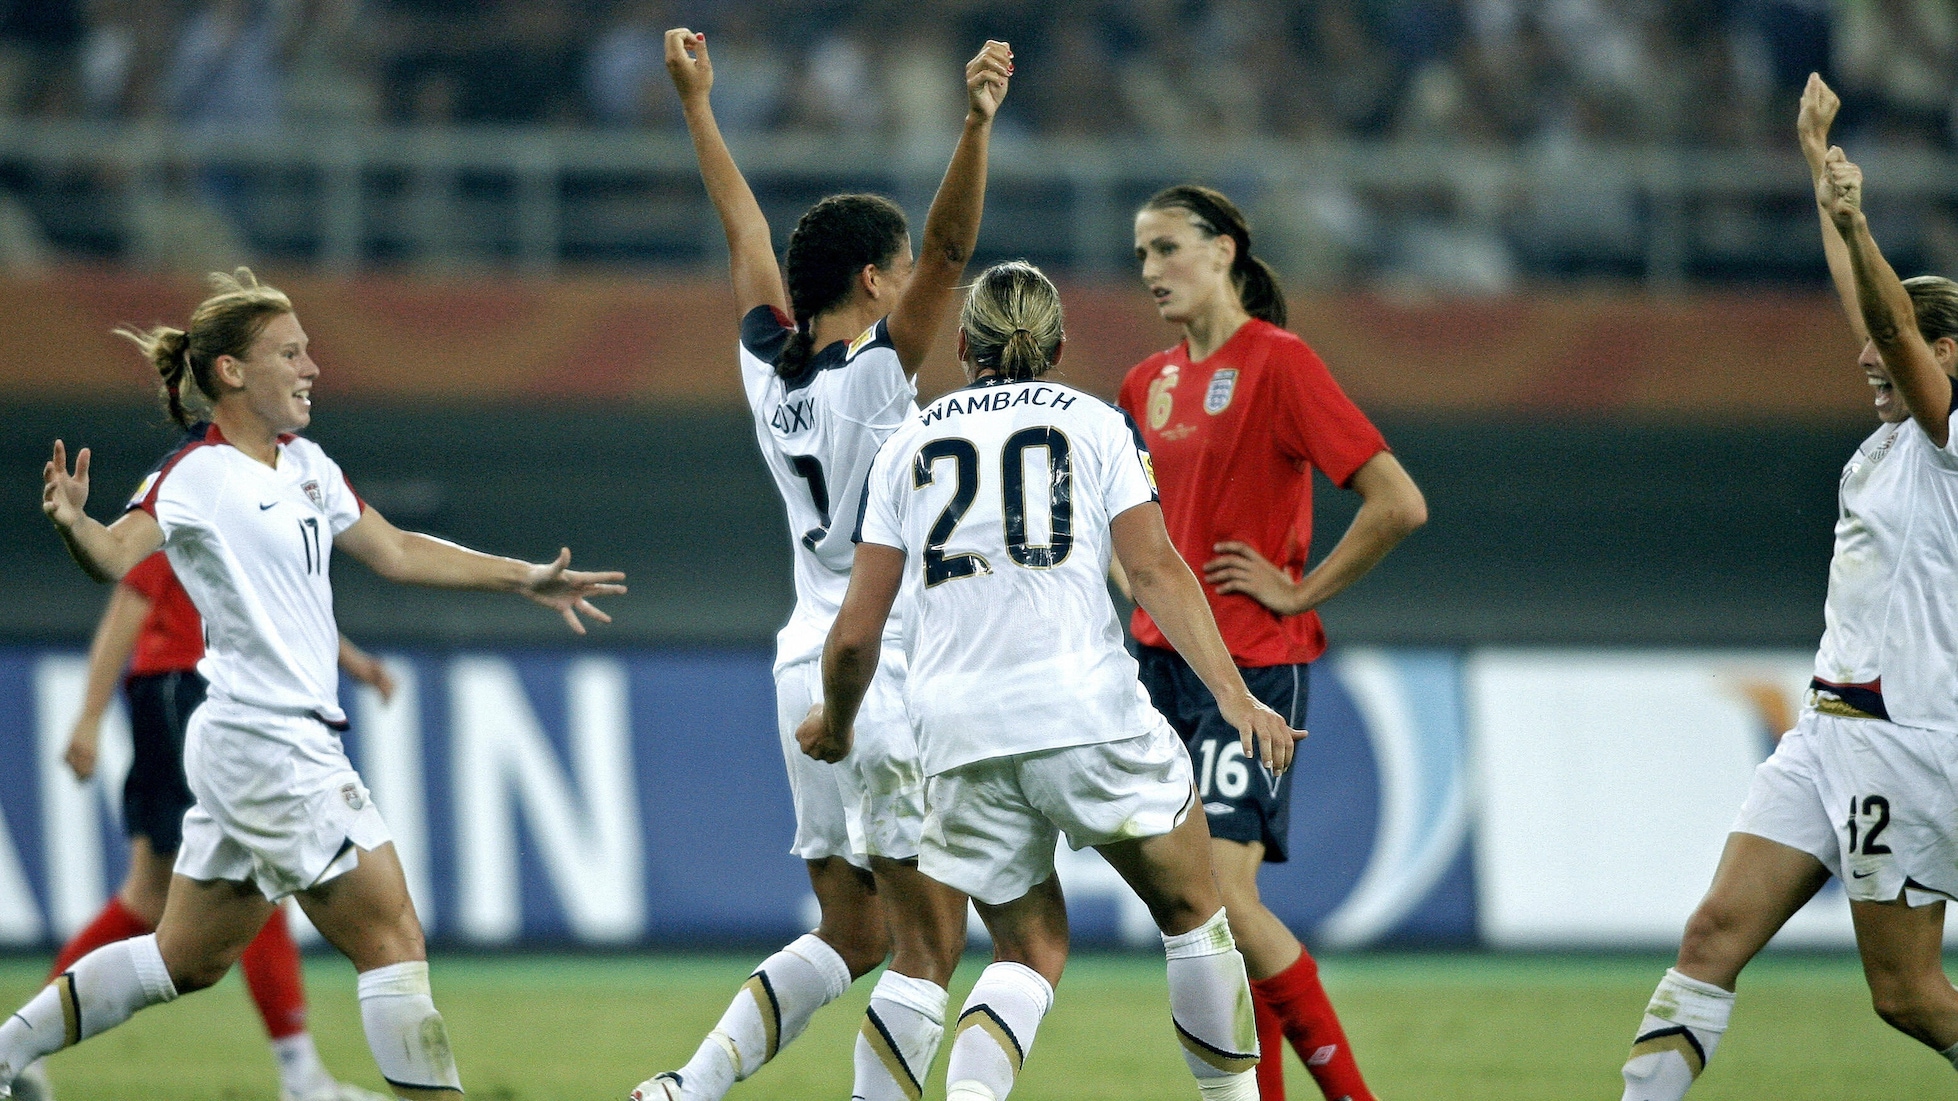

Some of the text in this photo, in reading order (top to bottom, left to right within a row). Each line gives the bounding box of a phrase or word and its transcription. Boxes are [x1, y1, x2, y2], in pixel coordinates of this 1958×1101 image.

[918, 387, 1077, 427] WAMBACH
[912, 425, 1074, 589] 20
[297, 516, 321, 575] 17
[1200, 739, 1249, 798] 16
[1847, 794, 1892, 855] 12
